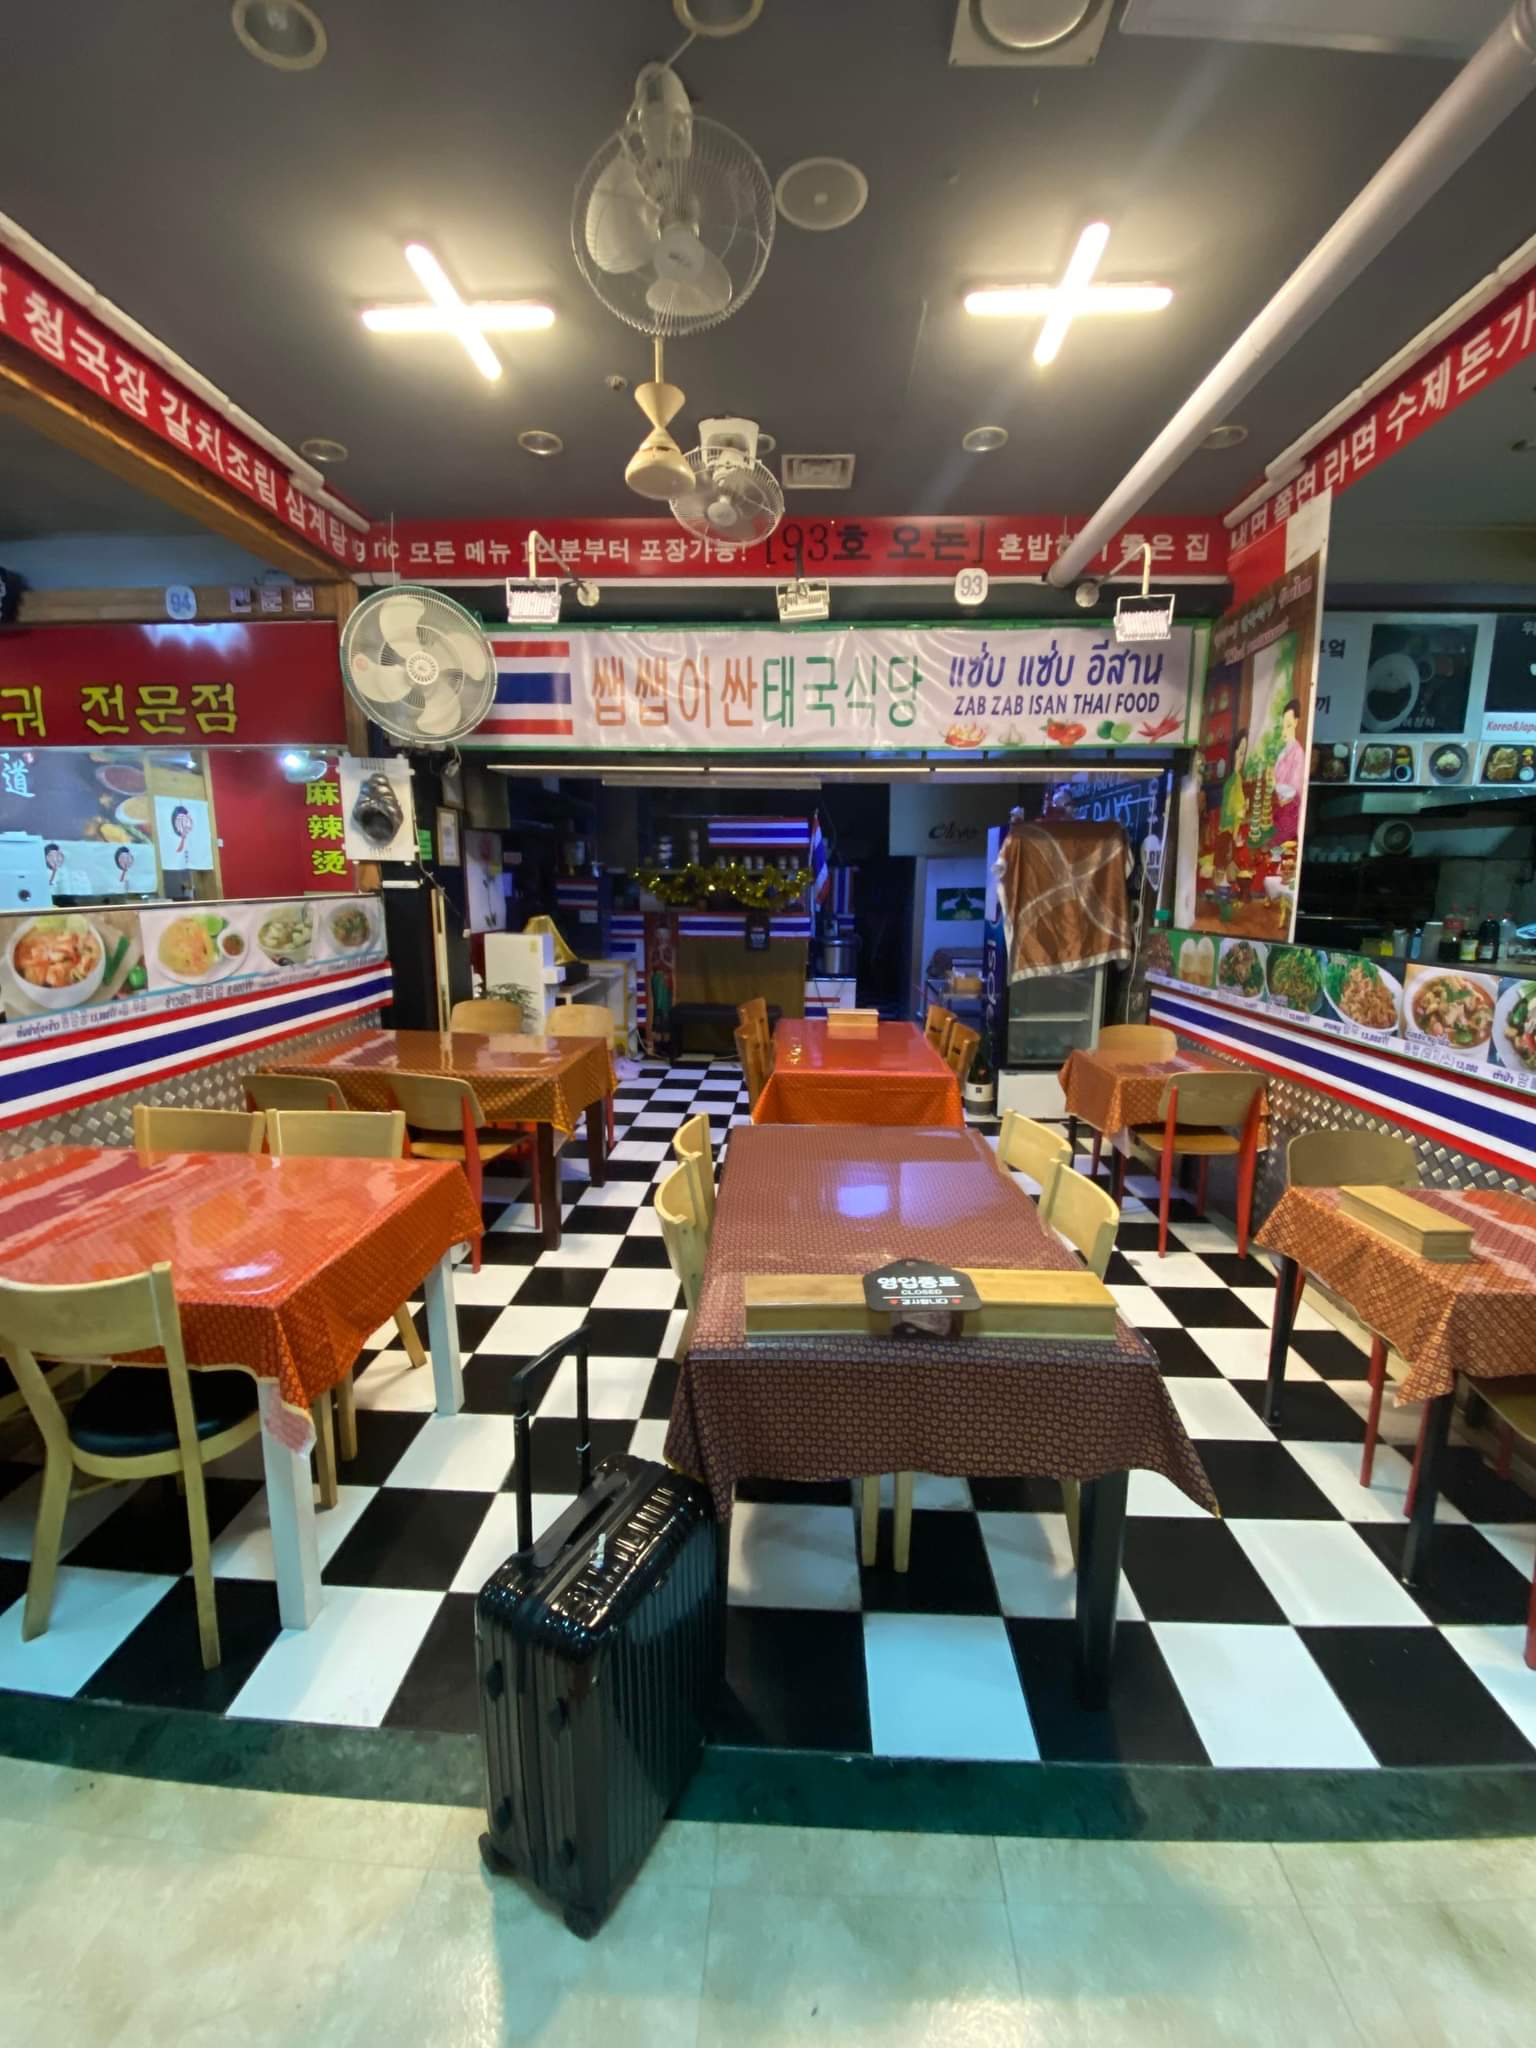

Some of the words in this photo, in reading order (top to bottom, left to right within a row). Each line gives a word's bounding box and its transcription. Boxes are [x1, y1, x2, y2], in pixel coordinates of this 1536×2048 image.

[24, 291, 150, 417] 청국장
[159, 388, 279, 511] 갈치조림
[285, 486, 348, 557] 삼계탕
[1324, 414, 1377, 489] 라면
[409, 540, 457, 564] 모든
[465, 540, 511, 565] 메뉴
[1185, 533, 1210, 562] 집
[170, 592, 192, 613] 94
[950, 641, 1006, 688] แซ่บ
[1018, 639, 1075, 687] แซ่บ
[1087, 639, 1164, 686] อีสาน
[80, 683, 238, 736] 전문점
[954, 696, 986, 716] ZAB
[991, 696, 1023, 716] ZAB
[1029, 695, 1067, 715] ISAN
[1074, 694, 1111, 714] THAI
[1115, 692, 1160, 713] FOOD
[877, 1276, 961, 1290] 영업종료
